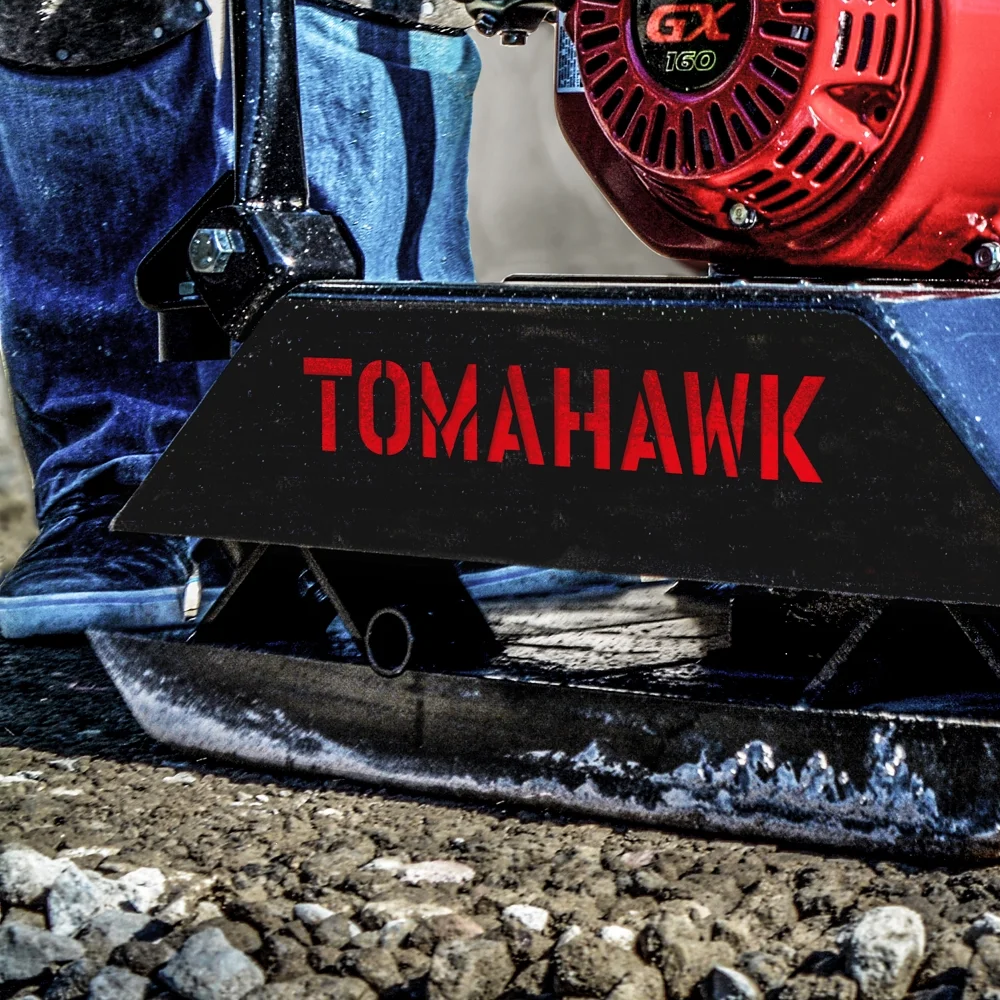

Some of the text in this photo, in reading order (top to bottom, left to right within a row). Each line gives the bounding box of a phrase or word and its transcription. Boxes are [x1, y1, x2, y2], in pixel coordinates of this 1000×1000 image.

[646, 2, 736, 43] GX
[665, 49, 717, 72] 160
[303, 357, 825, 483] TOMAHAWK
